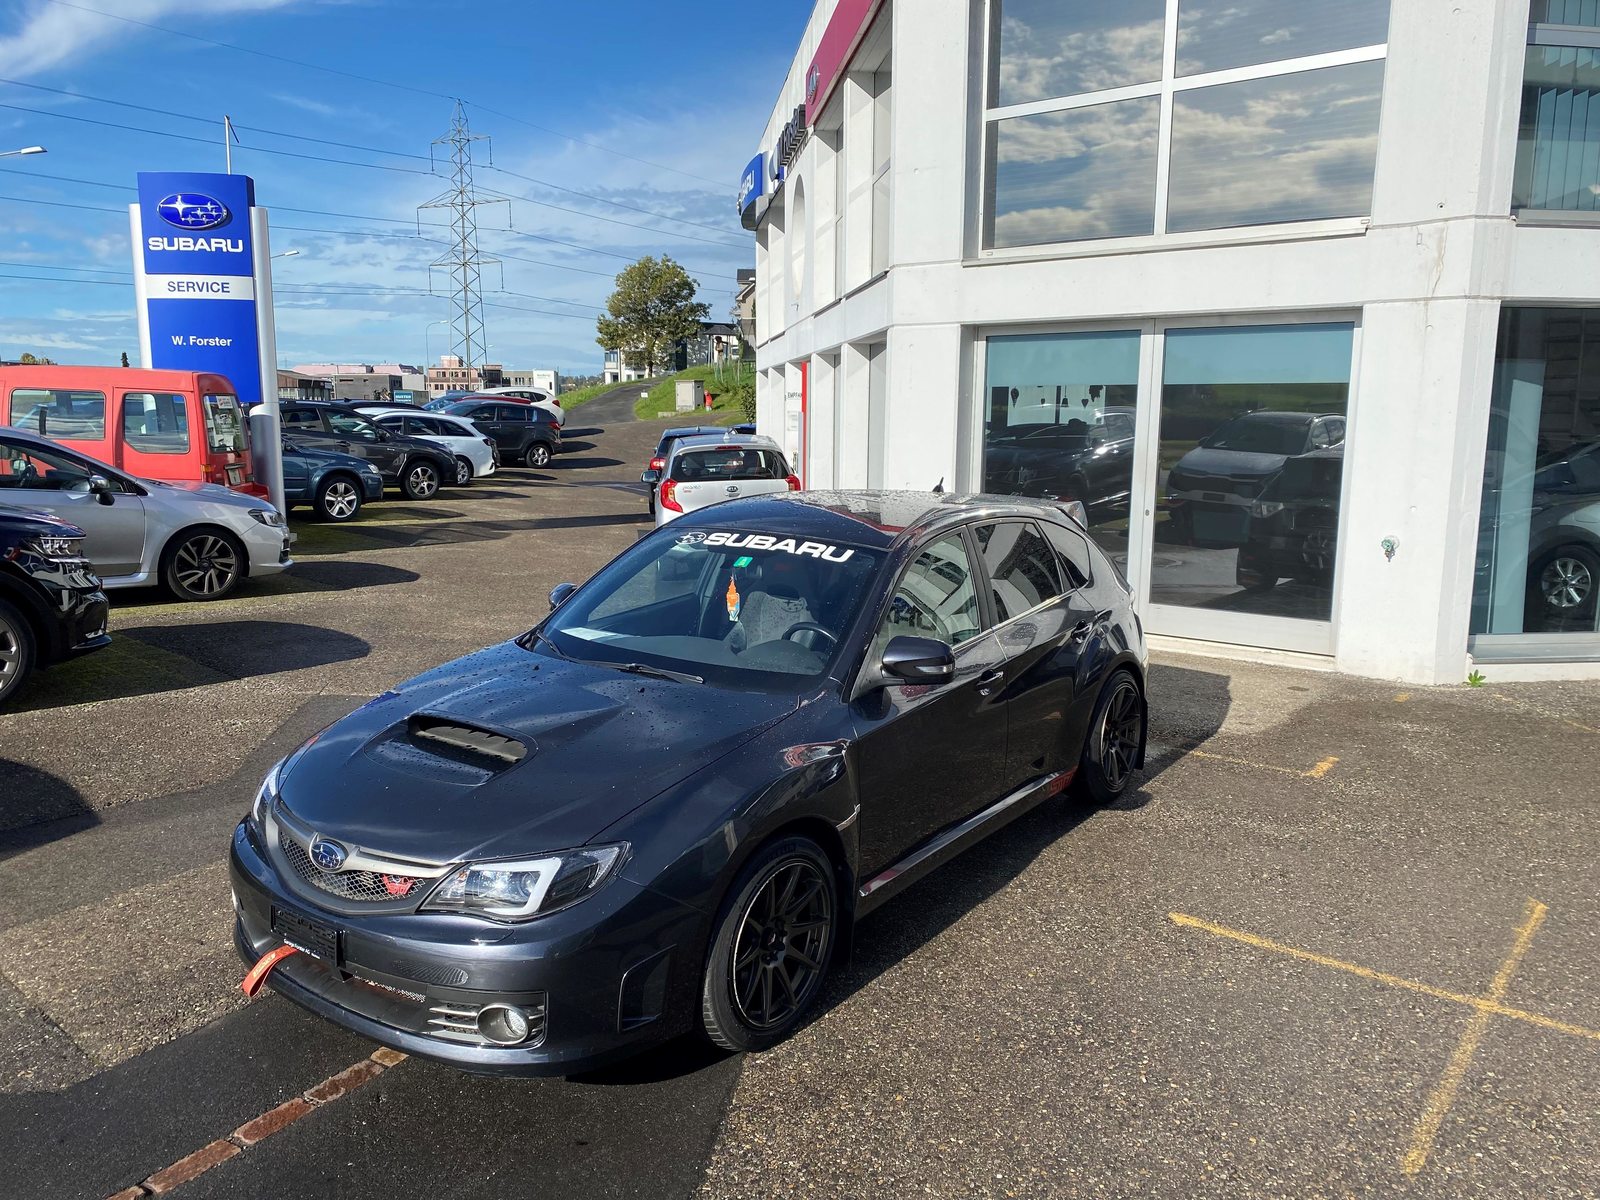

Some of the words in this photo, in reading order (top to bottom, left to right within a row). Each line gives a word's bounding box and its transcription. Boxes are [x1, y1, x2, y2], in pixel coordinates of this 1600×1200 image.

[148, 237, 244, 253] SUBARU
[167, 281, 231, 294] SERVICE
[171, 336, 187, 346] W.
[189, 336, 232, 347] Forster
[703, 532, 854, 562] SUBARU
